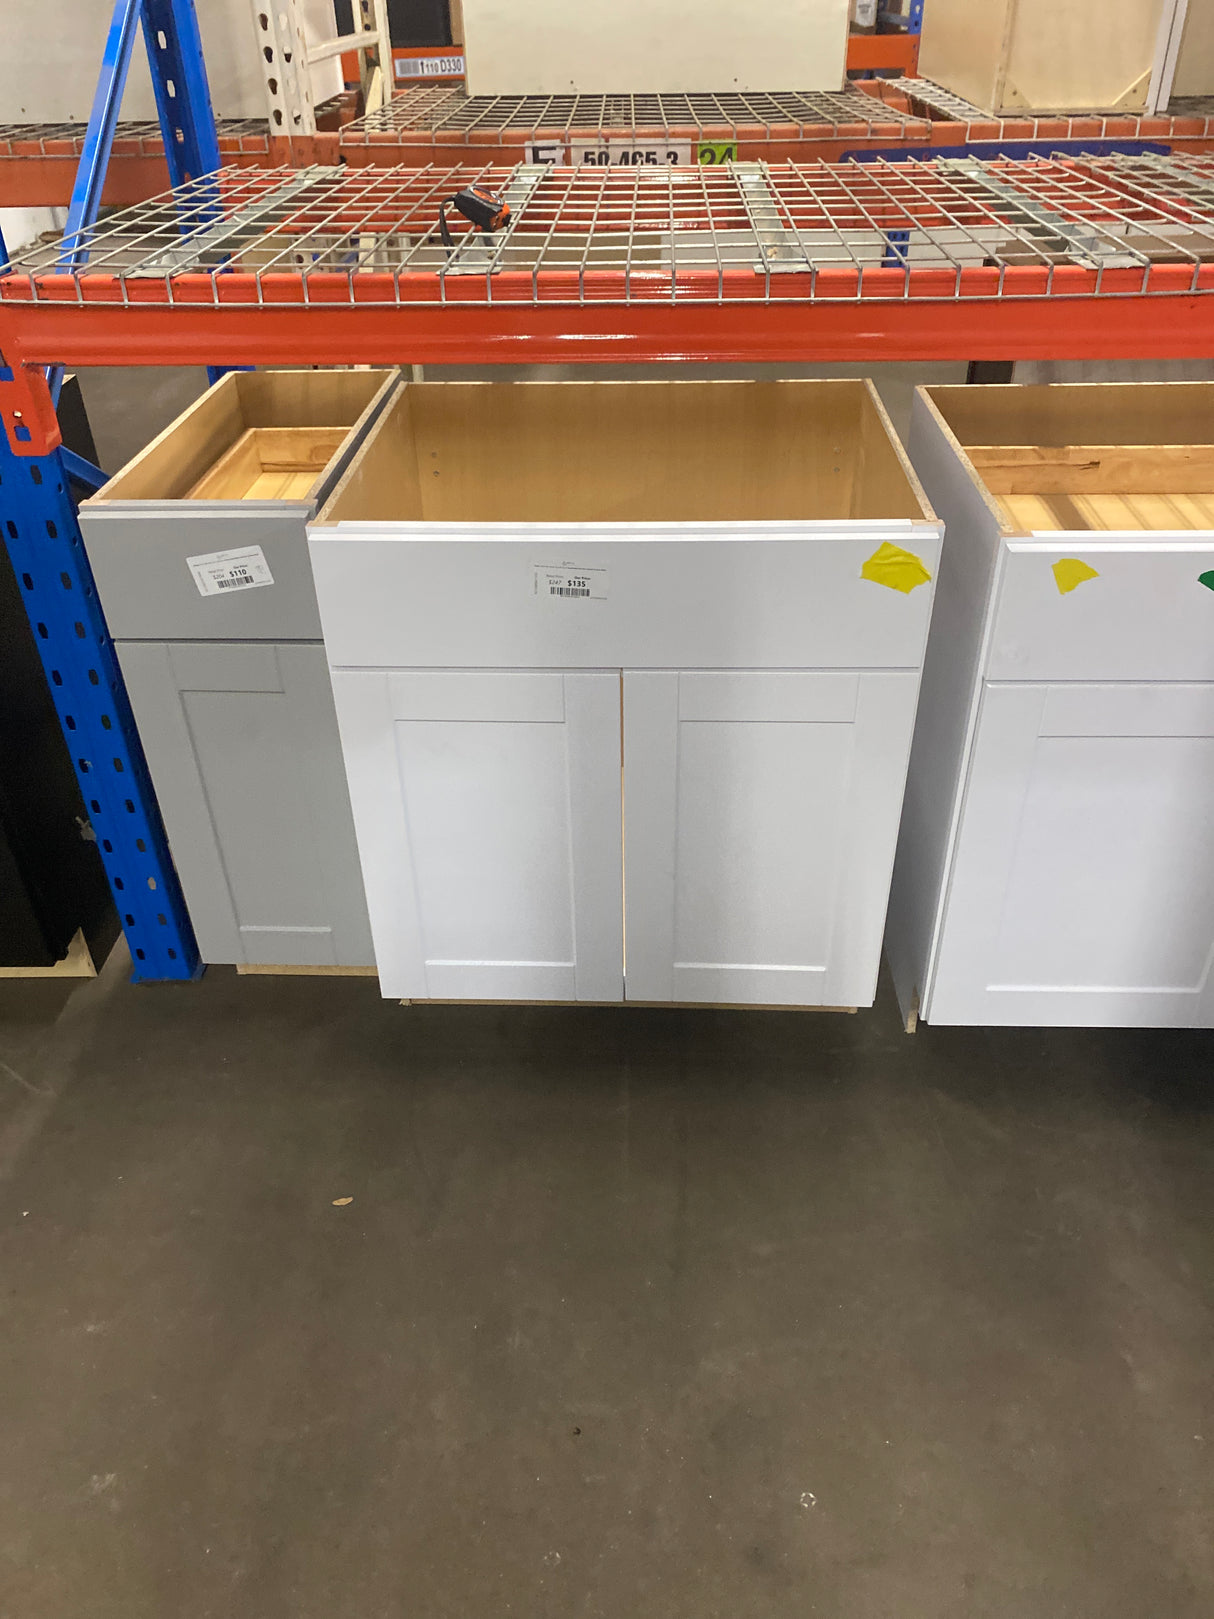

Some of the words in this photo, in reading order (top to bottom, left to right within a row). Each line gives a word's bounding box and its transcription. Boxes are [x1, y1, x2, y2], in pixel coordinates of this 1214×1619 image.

[440, 58, 462, 73] D330
[699, 147, 734, 166] 24
[229, 568, 247, 578] $110
[567, 579, 586, 587] $135
